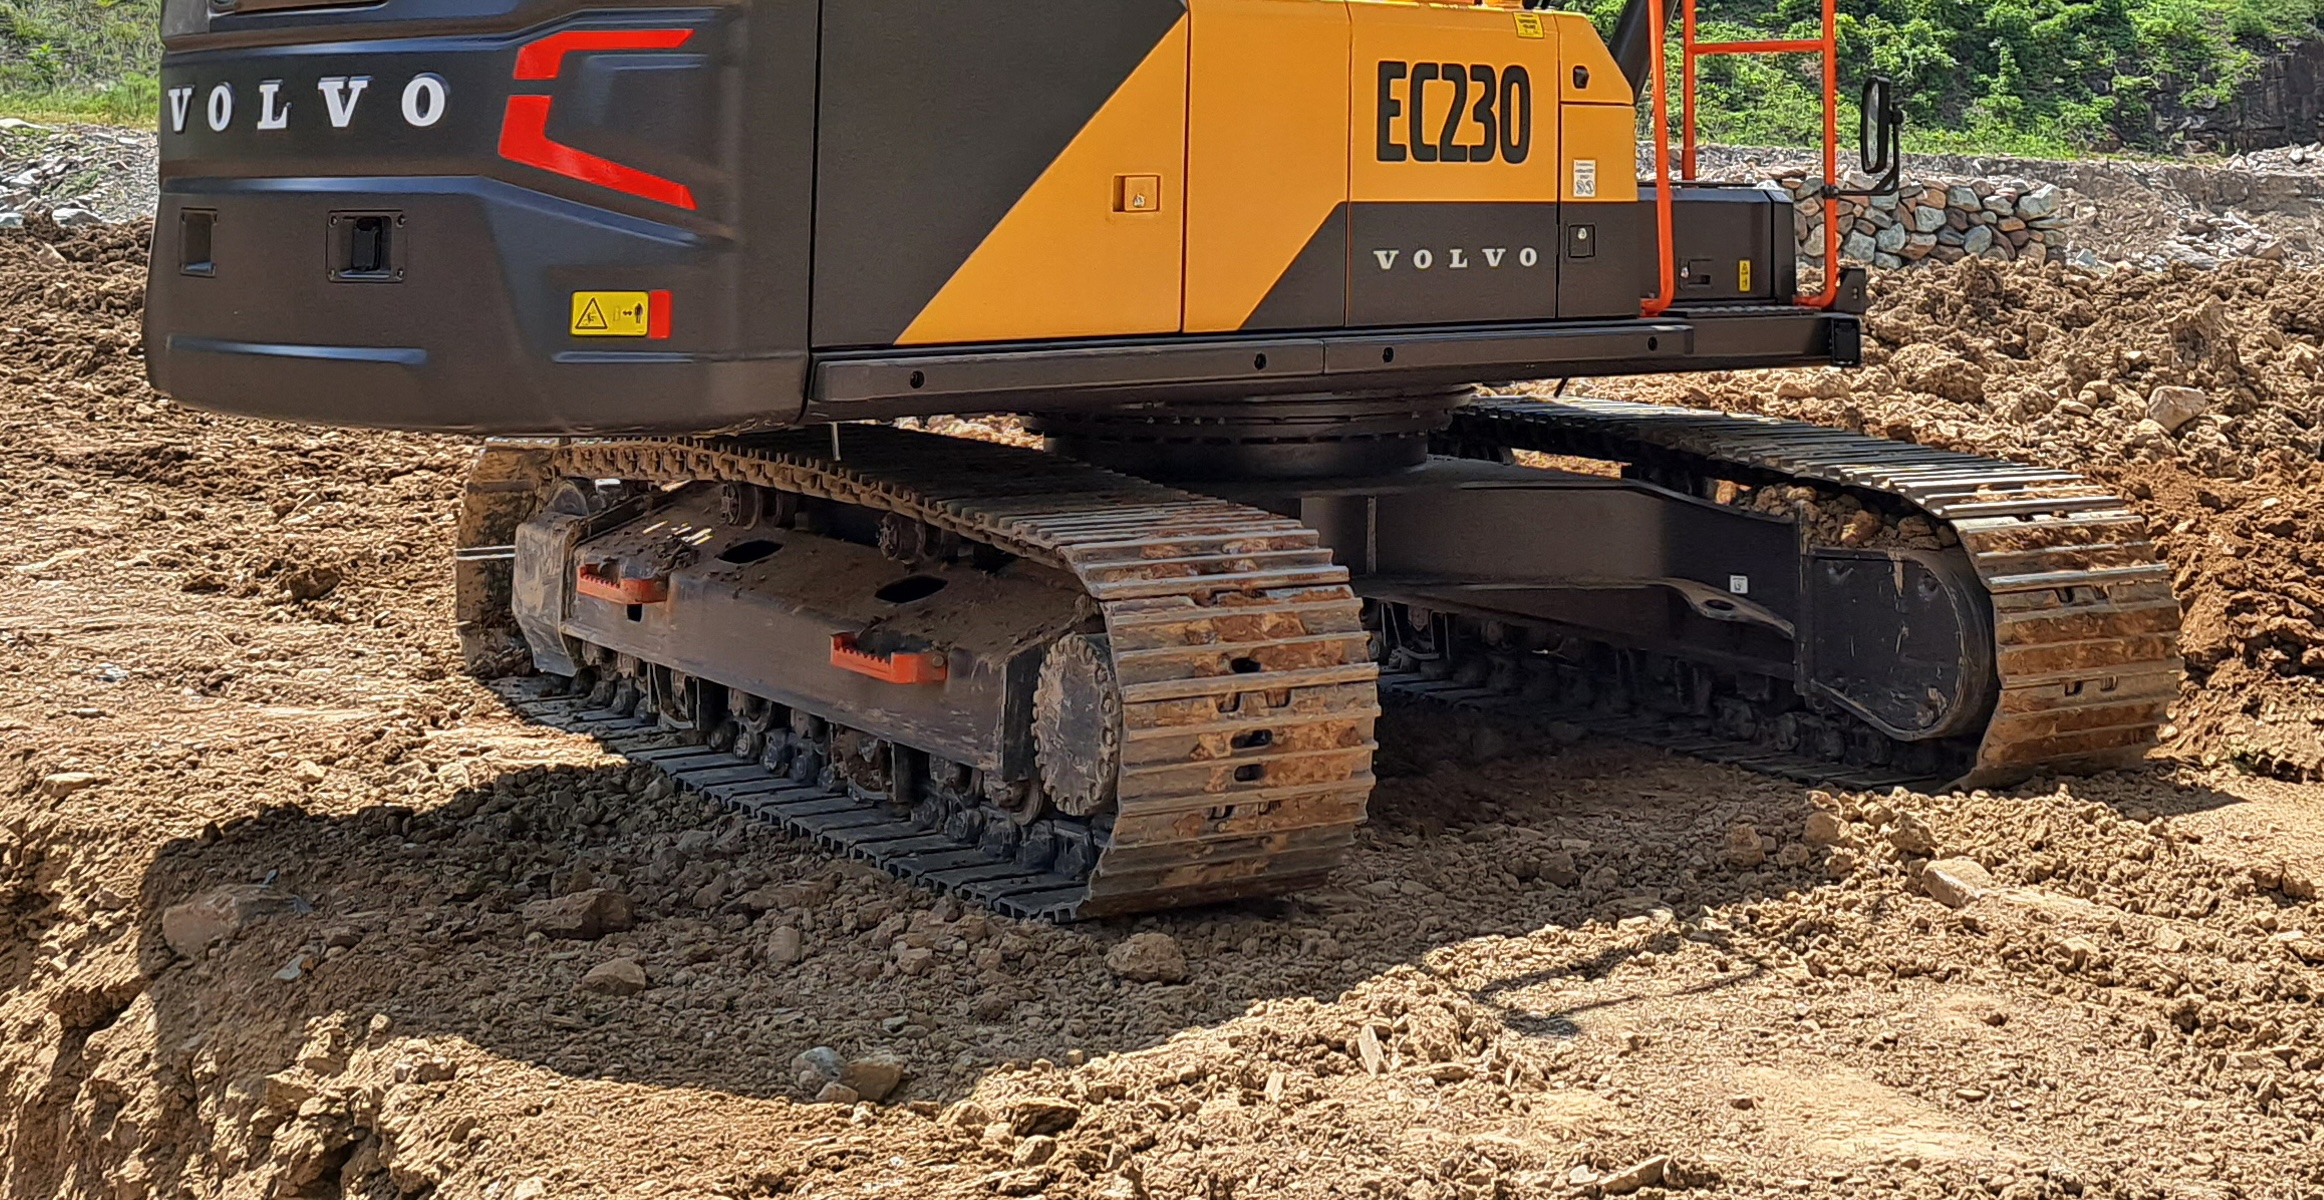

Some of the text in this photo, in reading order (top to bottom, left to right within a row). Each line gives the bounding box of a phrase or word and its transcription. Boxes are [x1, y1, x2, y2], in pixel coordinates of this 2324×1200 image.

[168, 75, 448, 132] VOLVO
[1376, 60, 1531, 164] EC230
[1373, 247, 1538, 270] VOLVO
